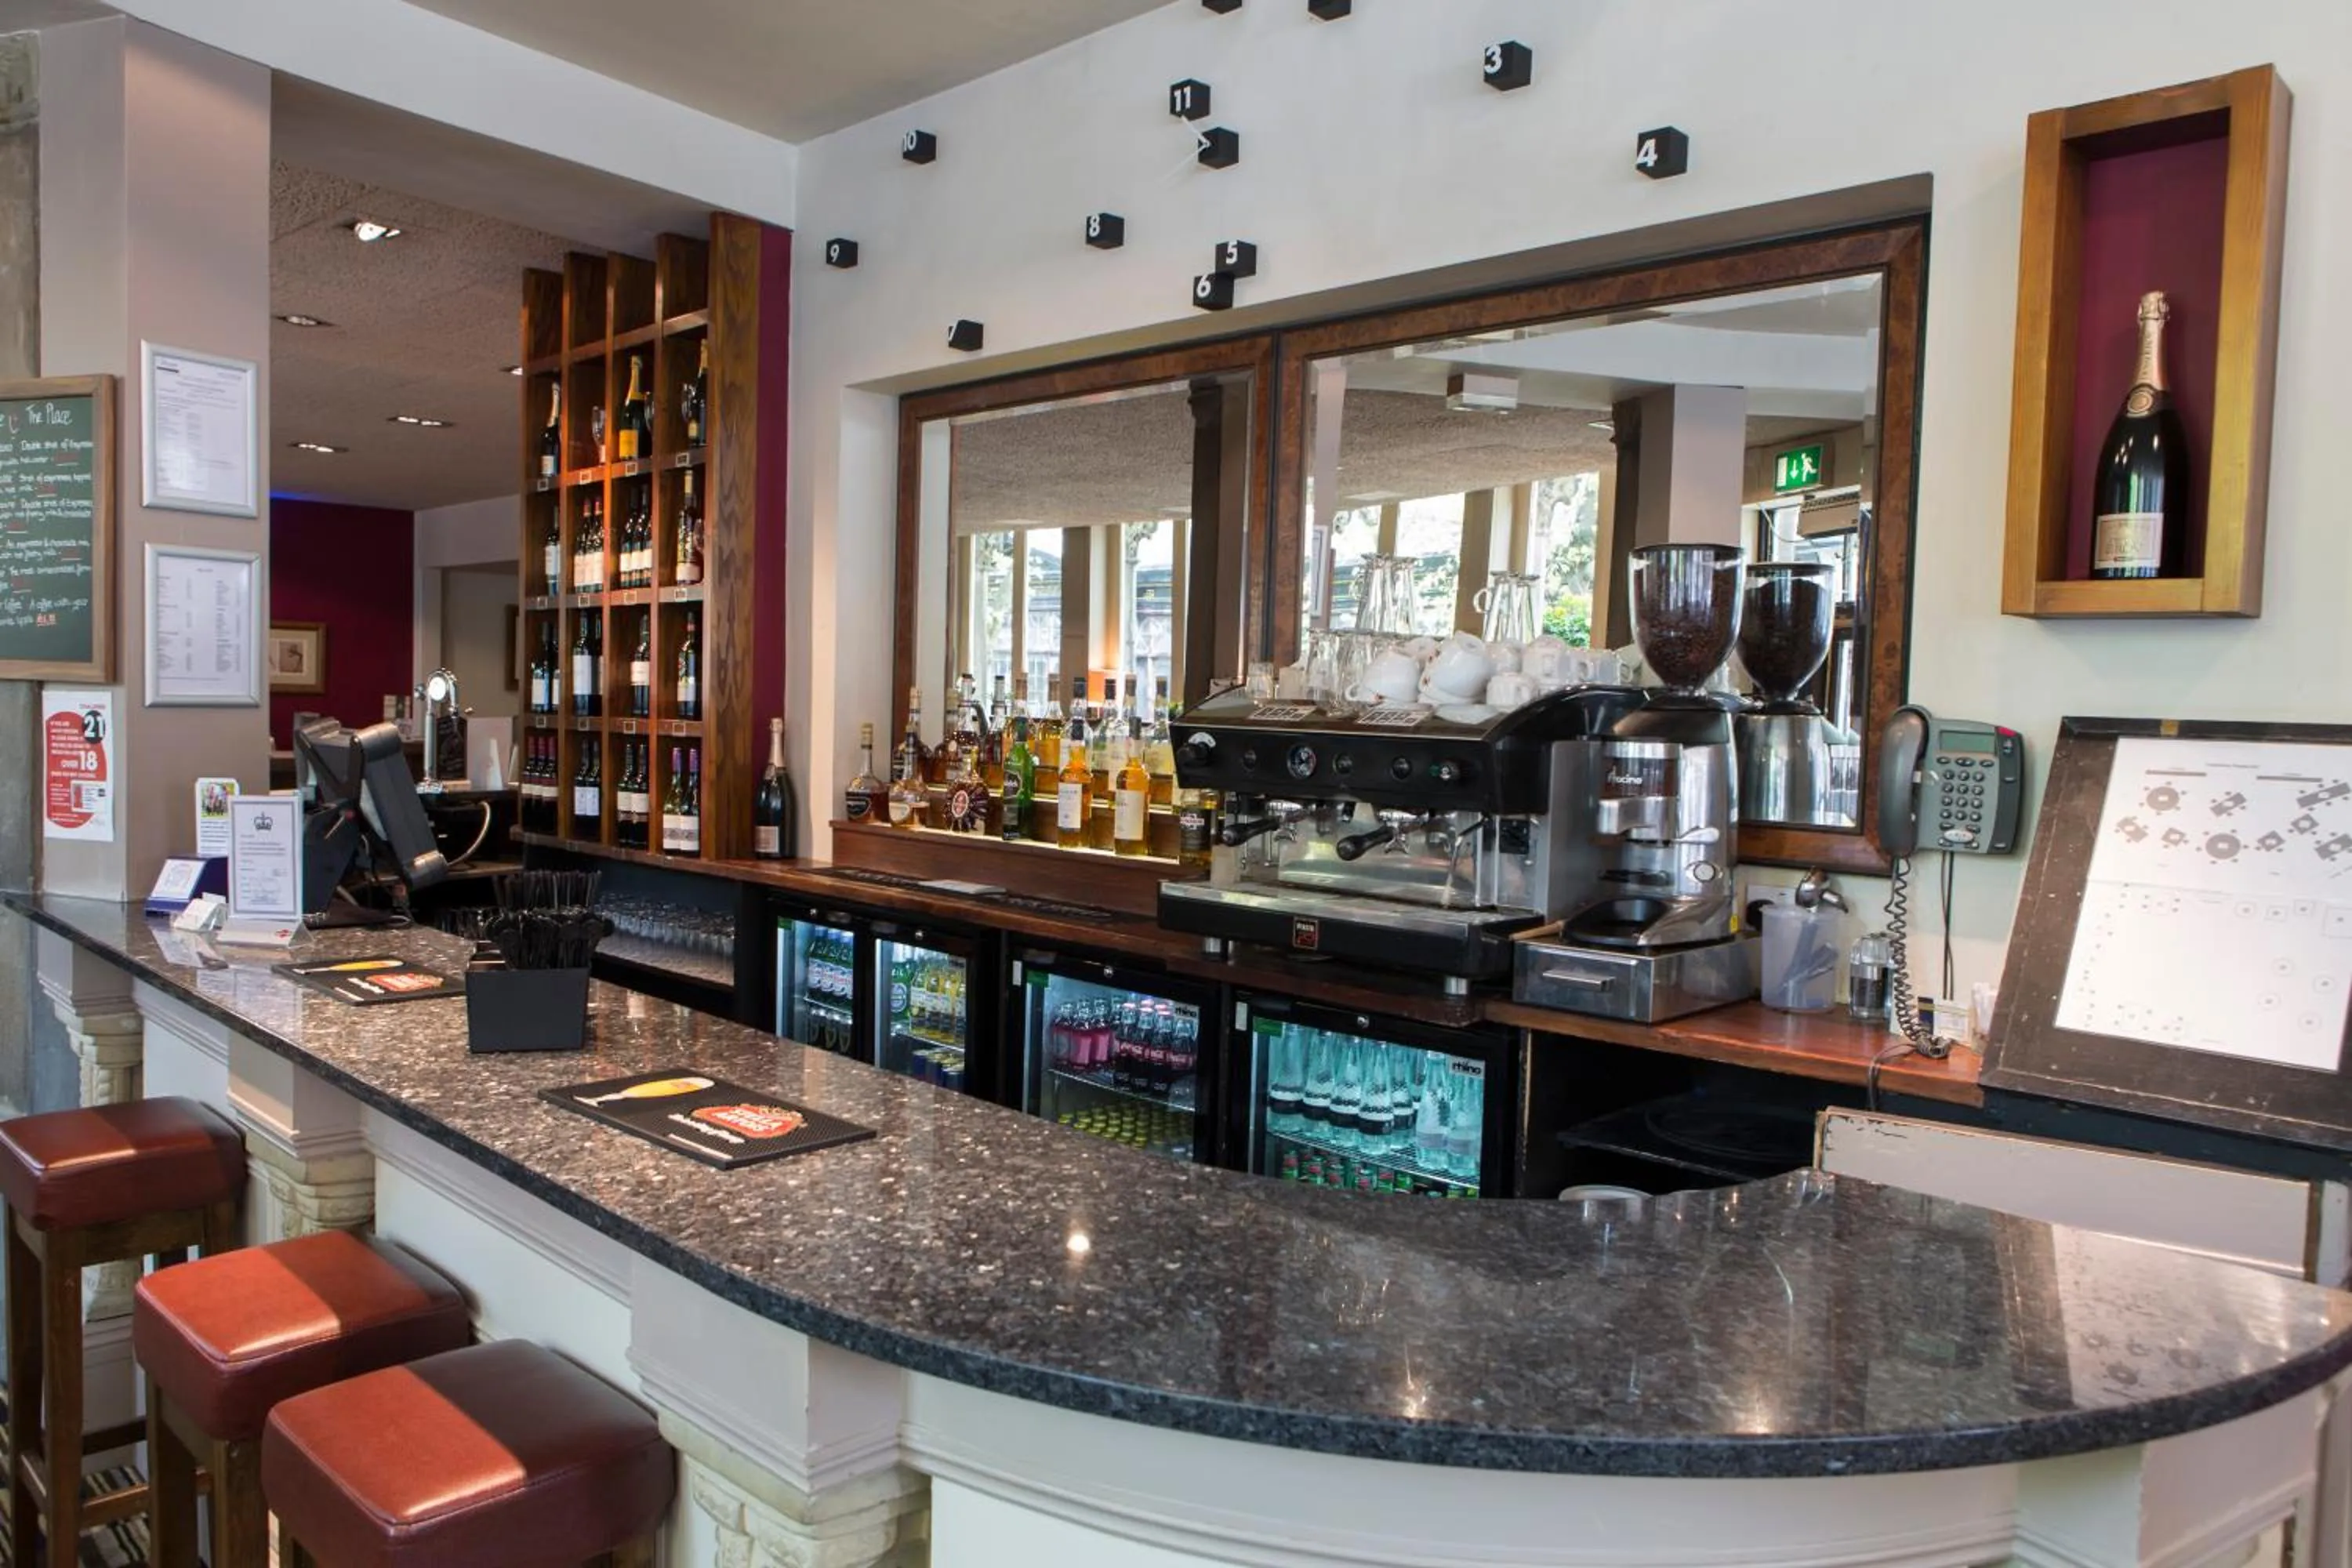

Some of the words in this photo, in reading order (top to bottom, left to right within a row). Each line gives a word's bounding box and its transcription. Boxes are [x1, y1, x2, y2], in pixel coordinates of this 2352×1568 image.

[1484, 43, 1502, 74] 3
[1174, 85, 1192, 113] 11
[902, 130, 916, 151] 10
[1635, 138, 1658, 167] 4
[1088, 214, 1101, 237] 8
[829, 245, 840, 262] 9
[1225, 242, 1237, 264] 5
[1196, 275, 1211, 298] 6
[84, 715, 105, 739] 21
[79, 750, 98, 772] 18
